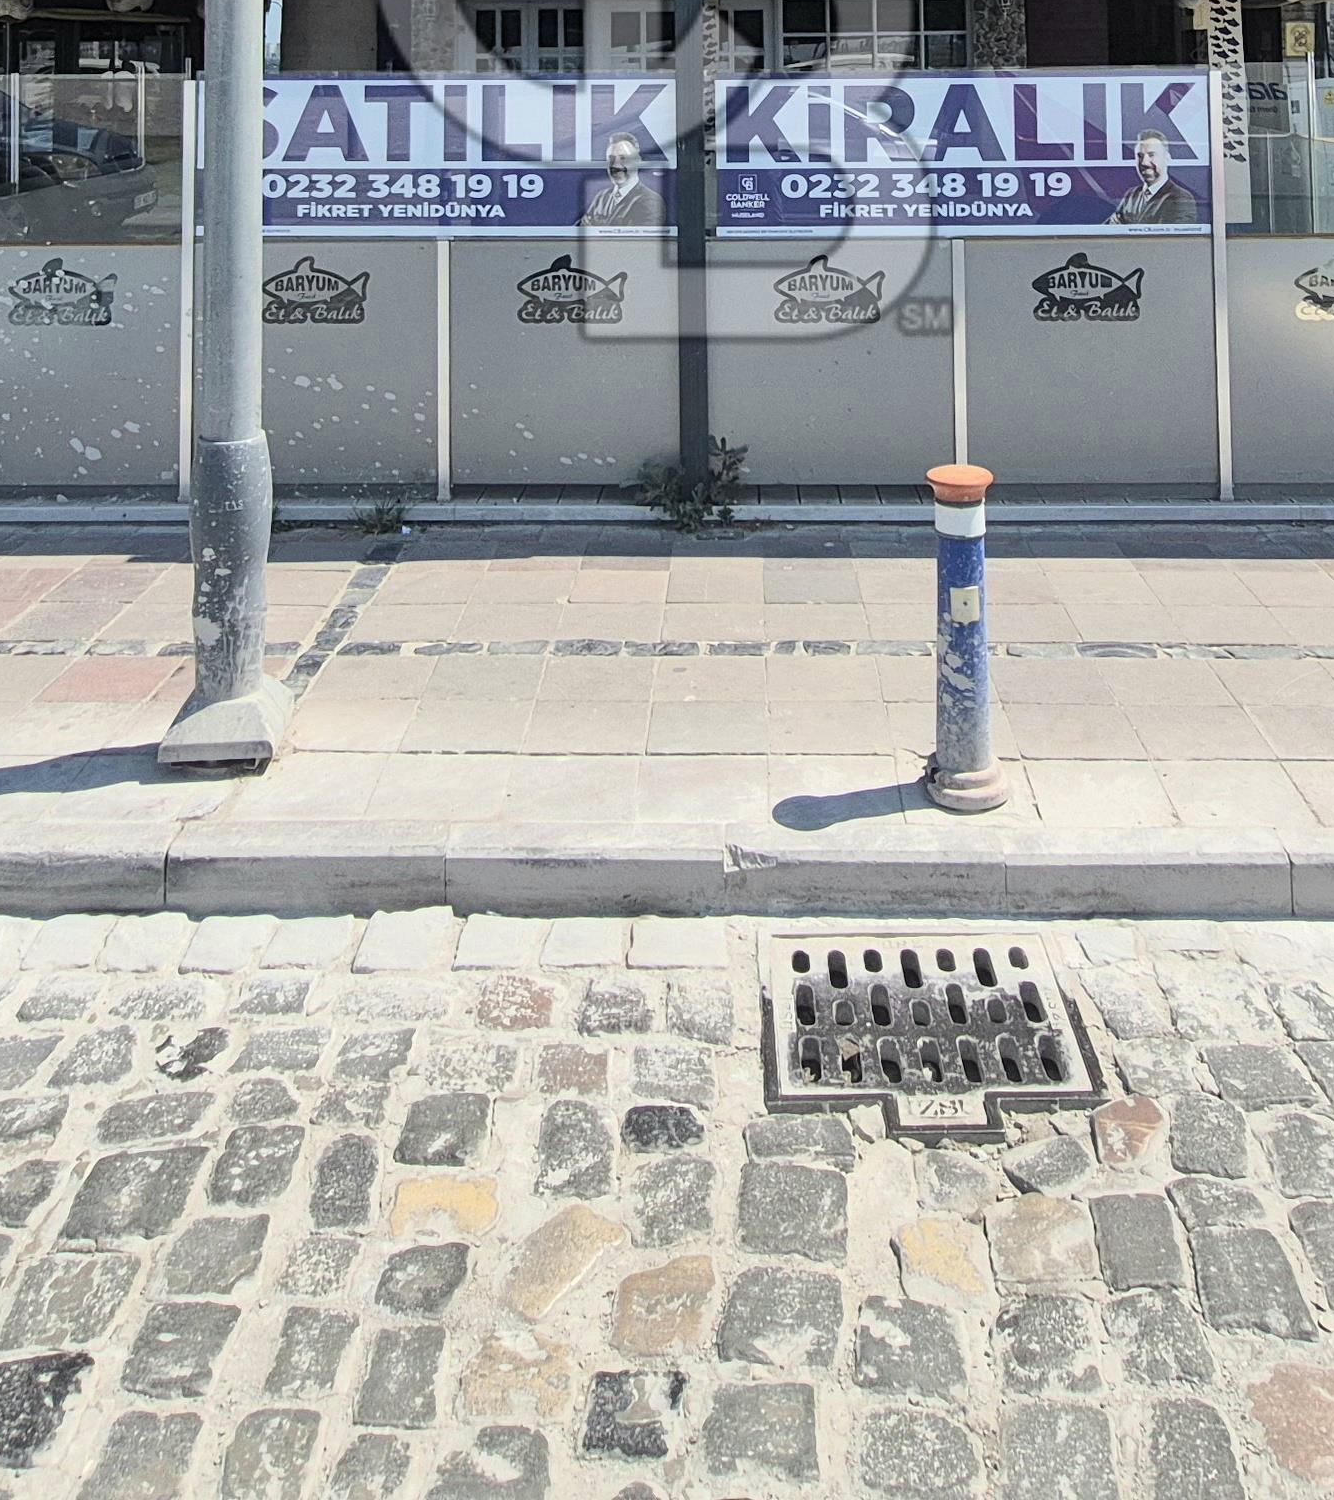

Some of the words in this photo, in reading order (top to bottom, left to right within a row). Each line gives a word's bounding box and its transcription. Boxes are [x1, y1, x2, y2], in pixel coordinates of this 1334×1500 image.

[366, 174, 440, 199] 348
[450, 174, 492, 199] 19
[502, 174, 544, 199] 19
[781, 174, 880, 199] 0232
[892, 173, 966, 198] 348
[977, 173, 1019, 198] 19
[1030, 172, 1072, 197] 19
[297, 201, 372, 218] FİKRET
[379, 201, 506, 218] YENİDÜNYA
[820, 201, 896, 218] FİKRET
[903, 200, 1034, 218] YENİDÜNYA
[275, 275, 340, 292] BARYUM
[531, 274, 596, 292] BARYUM
[788, 274, 854, 291] BARYUM
[266, 303, 285, 320] Et
[290, 307, 305, 320] &
[522, 303, 541, 320] Et
[547, 307, 562, 320] &
[778, 303, 798, 320] Et
[804, 307, 818, 320] &
[1038, 300, 1058, 317] Et
[1063, 304, 1078, 318] &
